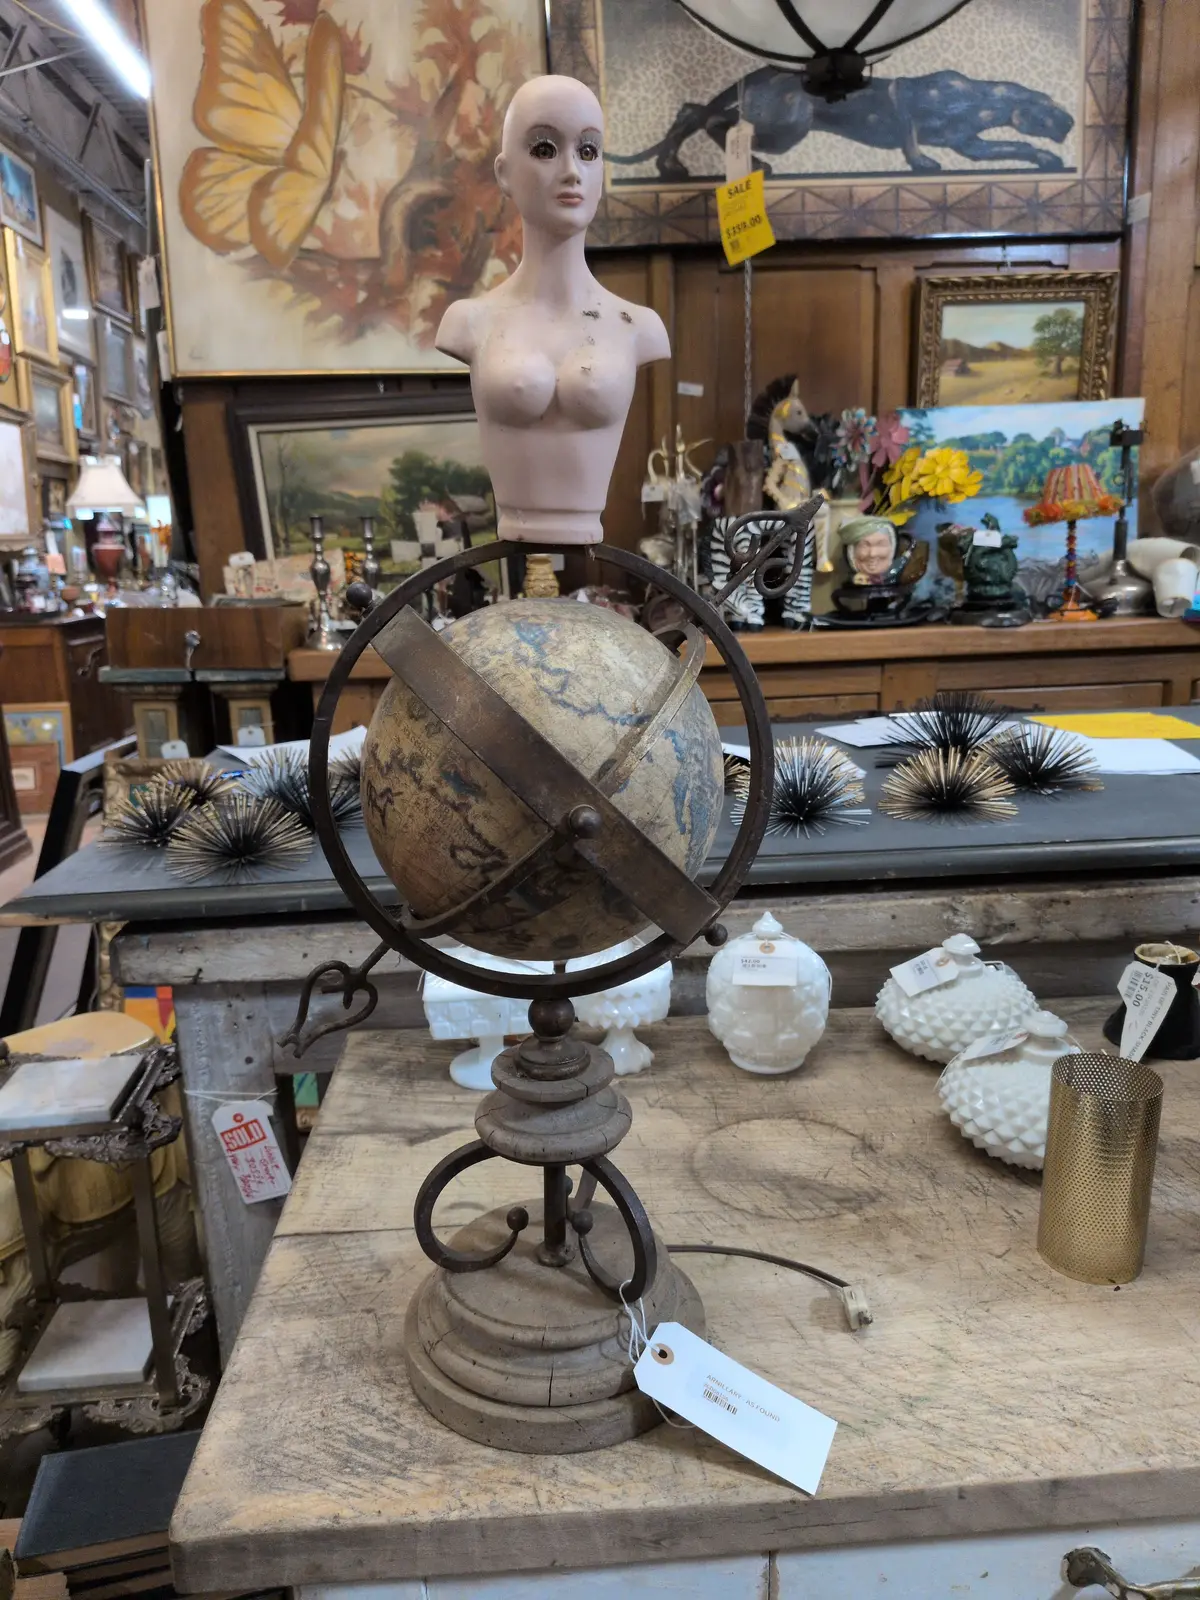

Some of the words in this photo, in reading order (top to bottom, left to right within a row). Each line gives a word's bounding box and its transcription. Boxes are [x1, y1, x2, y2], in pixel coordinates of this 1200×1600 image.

[727, 179, 752, 199] SALE
[1132, 972, 1154, 1007] $15.00
[1139, 1020, 1152, 1042] BLACK
[223, 1122, 263, 1150] SOLD
[745, 1400, 755, 1409] AS
[755, 1405, 780, 1423] FOUND
